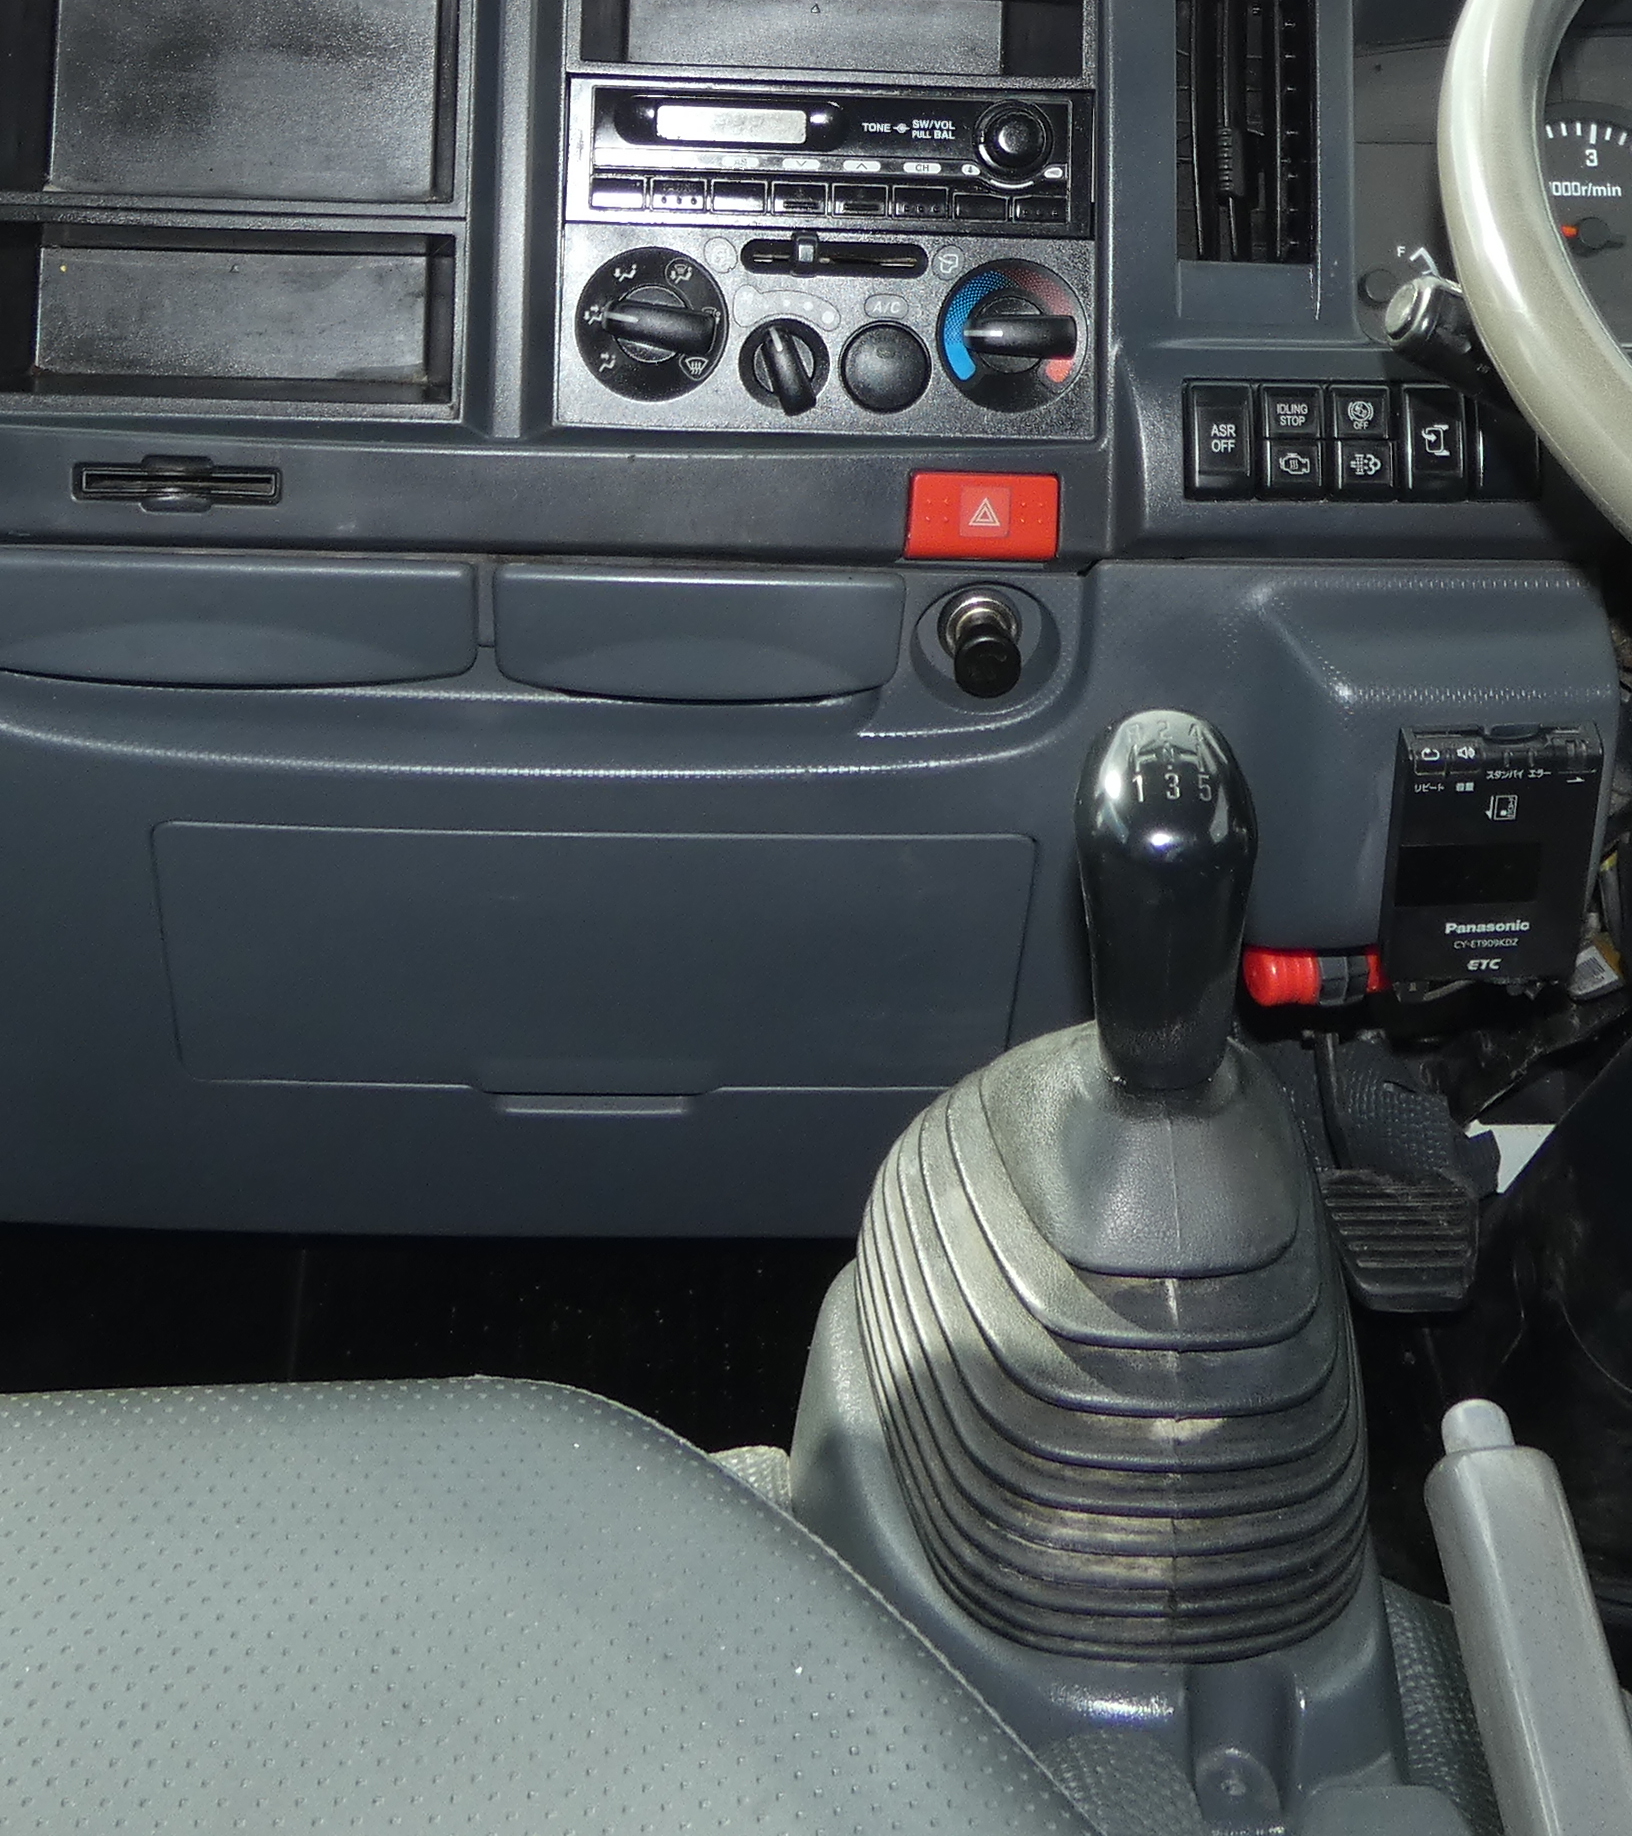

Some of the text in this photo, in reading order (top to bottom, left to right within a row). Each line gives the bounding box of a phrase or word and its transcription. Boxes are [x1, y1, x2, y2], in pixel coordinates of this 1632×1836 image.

[861, 119, 956, 133] TONE SW/VOL
[911, 130, 956, 140] PULL BAL
[1585, 149, 1598, 167] 3
[915, 163, 930, 172] CH
[1396, 247, 1405, 258] F
[871, 301, 900, 313] A/C
[1277, 403, 1308, 415] IDLING
[1280, 416, 1305, 426] STOP
[1353, 422, 1369, 430] OFF
[1211, 424, 1236, 436] ASR
[1211, 440, 1236, 453] OFF
[1156, 719, 1173, 740] 2
[1527, 768, 1552, 779] エラー
[1132, 773, 1213, 803] 1 3 5
[1445, 920, 1530, 935] Panasonic
[1467, 958, 1503, 970] ETC
